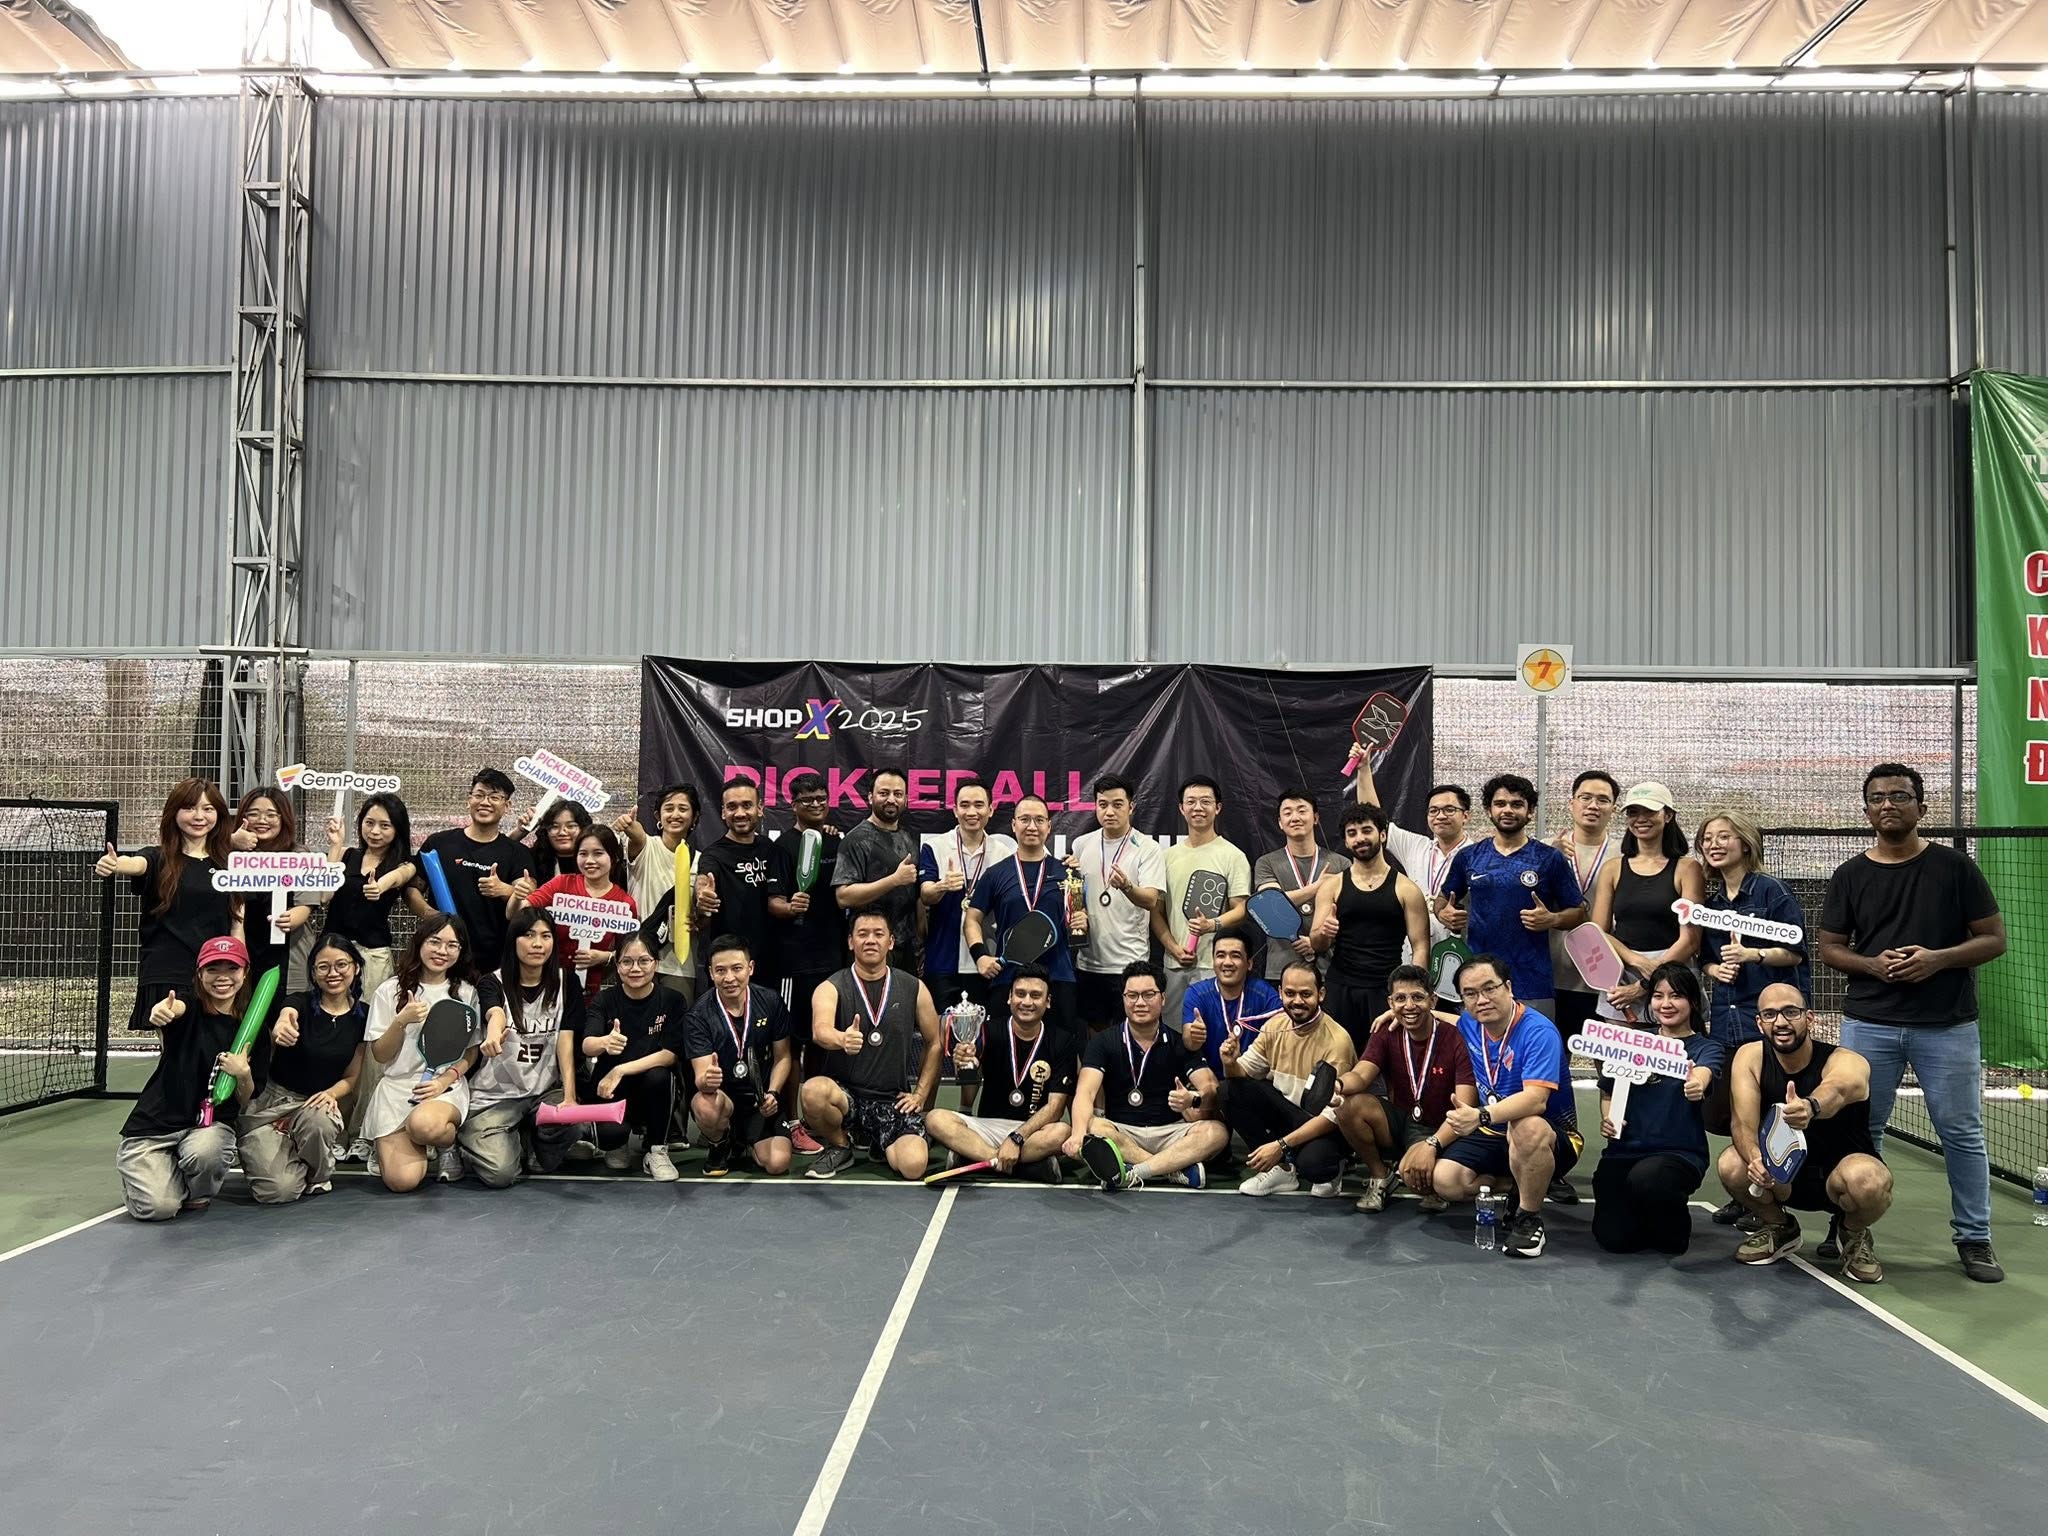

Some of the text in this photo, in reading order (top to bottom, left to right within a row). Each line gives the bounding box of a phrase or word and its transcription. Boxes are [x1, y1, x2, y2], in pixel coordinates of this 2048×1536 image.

[1538, 662, 1552, 679] 7
[838, 710, 929, 731] 2025
[301, 773, 397, 791] GemPages
[536, 752, 599, 794] PICKLEBALL
[517, 759, 601, 810] CHAMPIONSHIP
[723, 765, 1096, 811] PICKEBALL
[233, 856, 325, 869] PICKLEBALL
[462, 861, 491, 871] GemPage
[217, 874, 341, 888] CHAMPIONSHIP
[556, 897, 629, 916] PICKLEBALL
[1692, 908, 1798, 939] GemCommerce
[572, 928, 602, 939] 2025
[1586, 1023, 1683, 1056] PICKLEBALL
[517, 1042, 544, 1064] 23
[1606, 1063, 1647, 1081] 2025
